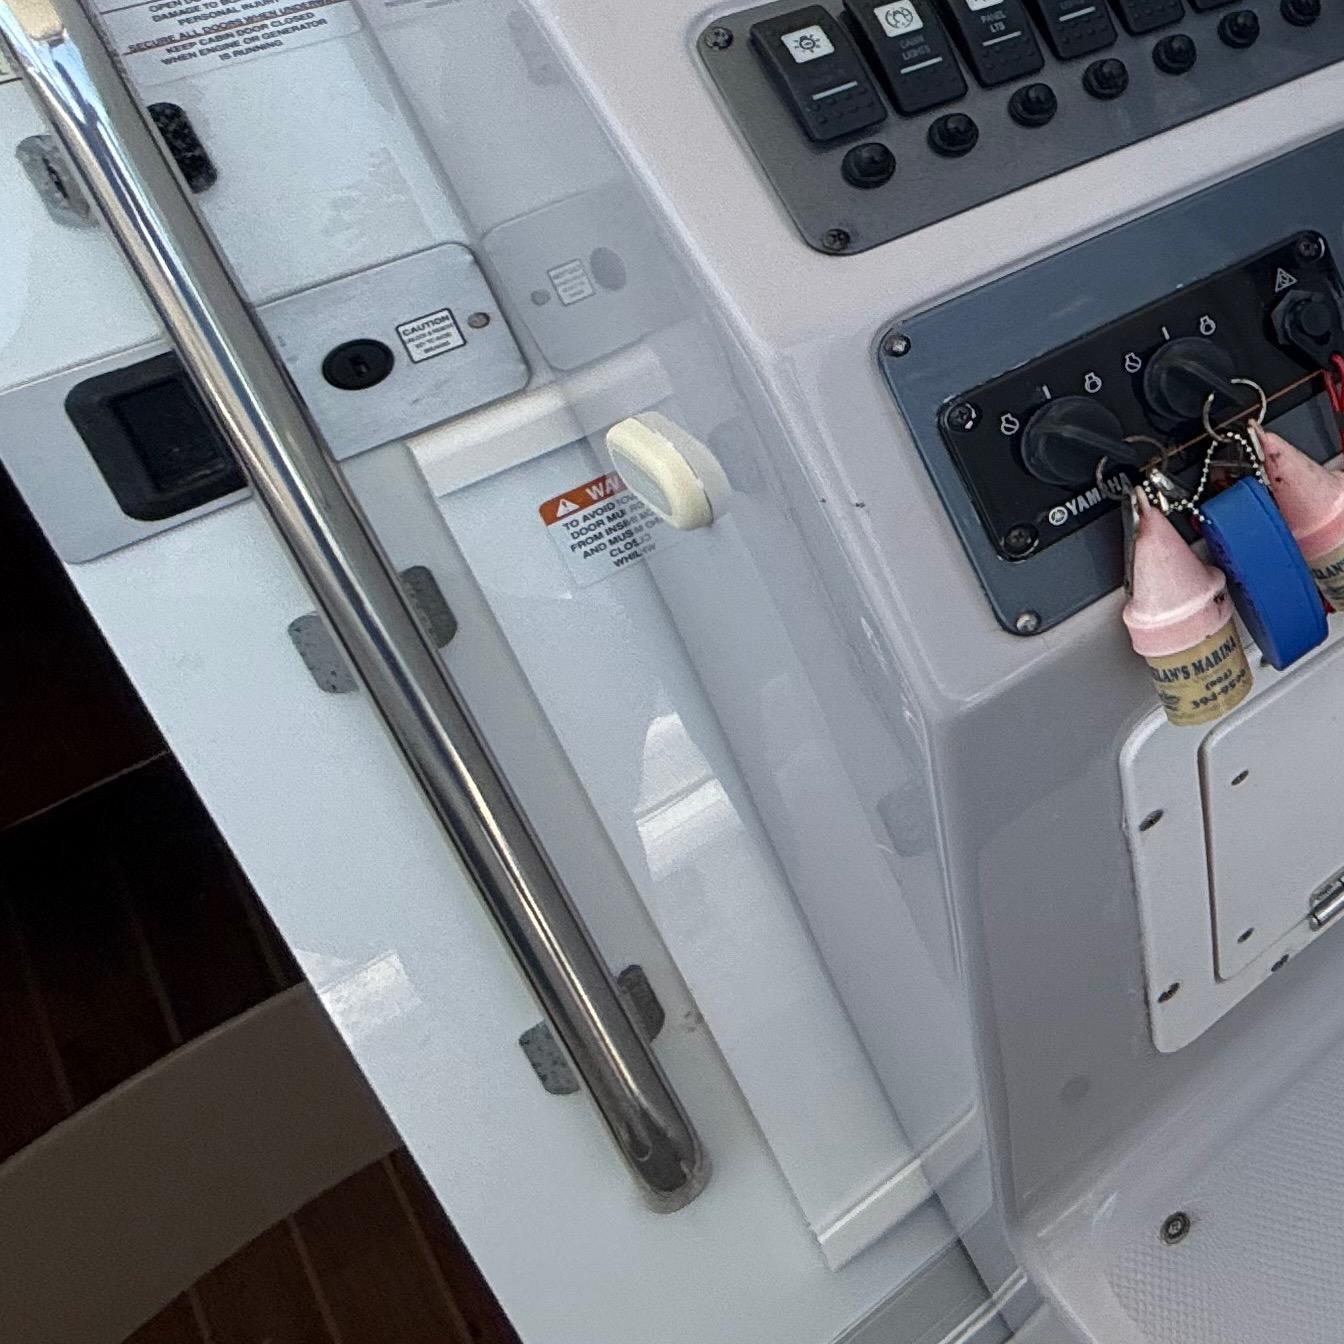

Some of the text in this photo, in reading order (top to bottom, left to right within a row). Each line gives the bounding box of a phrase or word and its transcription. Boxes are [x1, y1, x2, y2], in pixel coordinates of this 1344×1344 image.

[151, 4, 202, 22] DAMAGE
[202, 0, 218, 9] TO
[176, 5, 239, 26] PERSONAL
[127, 34, 177, 52] SECURE
[177, 28, 200, 39] ALL
[201, 18, 244, 34] DOORS
[244, 10, 278, 23] WHEN
[161, 17, 328, 65] WHEN ENGINE OR GENERATOR
[164, 11, 315, 54] KEEP CABIN DOOR CLOSED
[218, 39, 283, 60] IS RUNNING
[402, 314, 450, 336] CAUTION
[562, 502, 616, 531] TO AVOID
[570, 519, 605, 540] DOOR
[570, 531, 604, 552] FROM
[583, 529, 634, 559] AND MUS
[613, 550, 643, 567] WHIL
